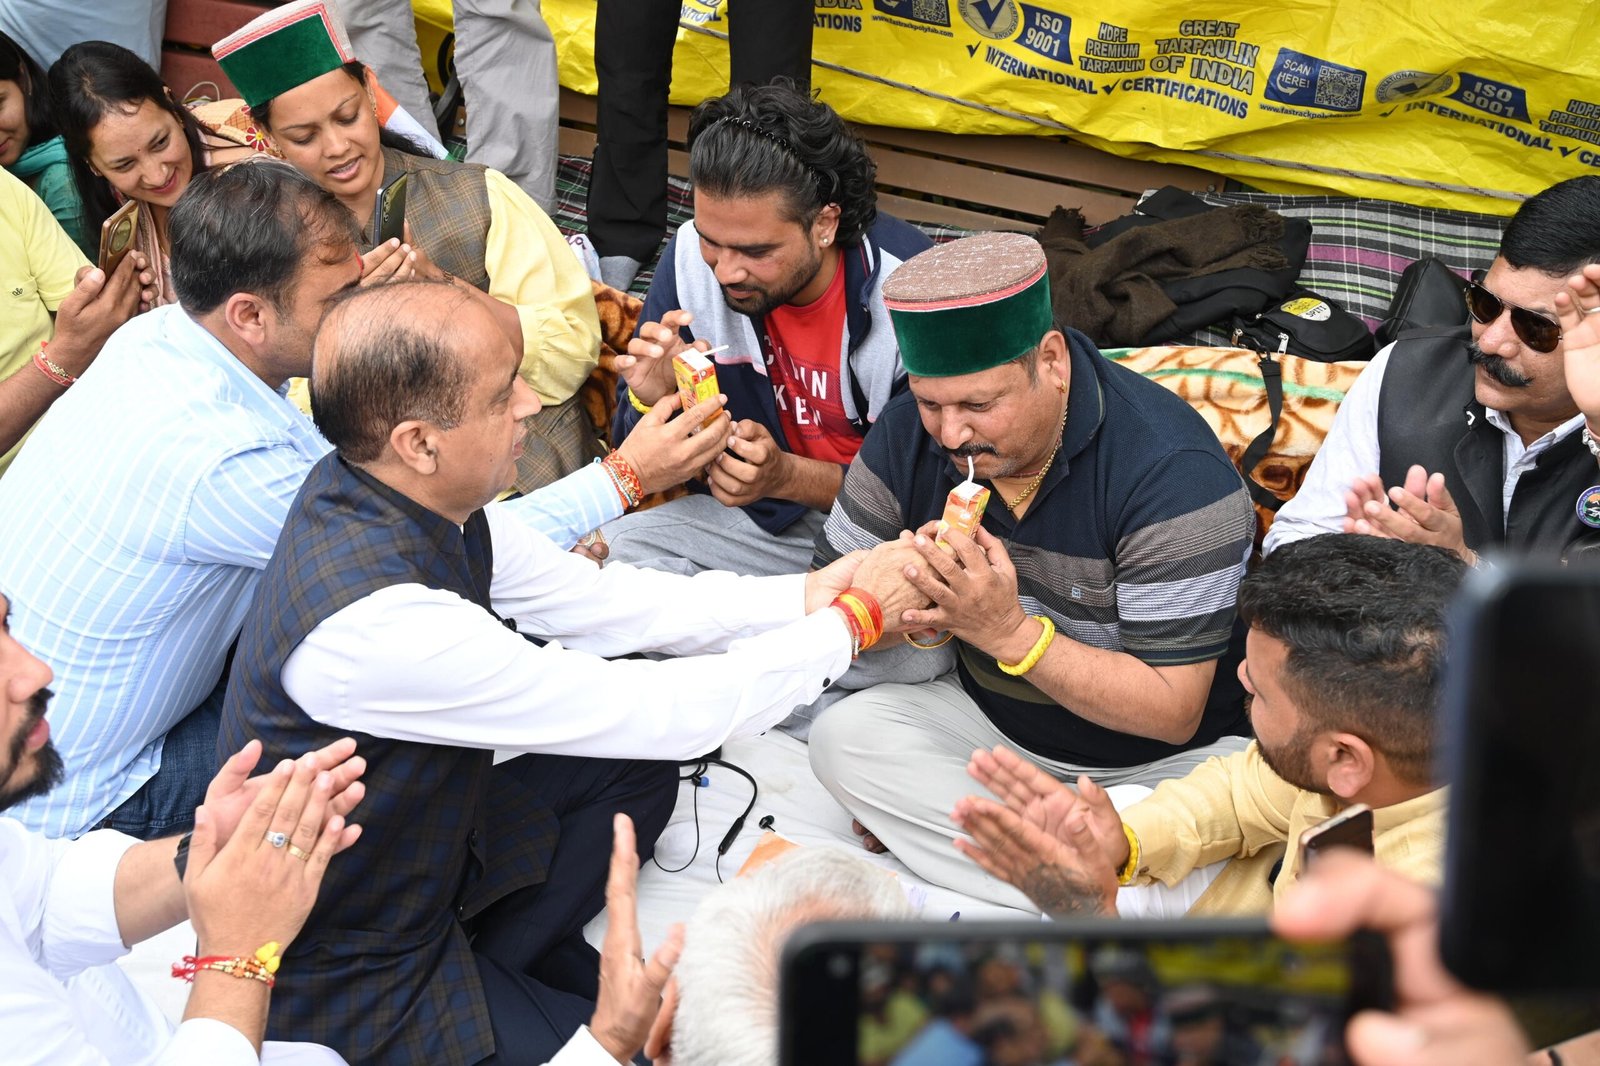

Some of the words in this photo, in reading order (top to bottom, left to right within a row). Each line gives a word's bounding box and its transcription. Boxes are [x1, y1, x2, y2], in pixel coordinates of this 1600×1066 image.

[1034, 12, 1063, 34] ISO
[1098, 22, 1128, 43] HDPE
[1179, 20, 1240, 38] GREAT
[1025, 27, 1061, 57] 9001
[1086, 39, 1140, 58] PREMIUM
[1155, 39, 1260, 68] TARPAULIN
[985, 45, 1098, 95] INTERNATIONAL
[1079, 56, 1145, 74] TARPAULIN
[1150, 56, 1186, 74] OF
[1190, 58, 1255, 95] INDIA
[1282, 58, 1312, 76] SCAN
[1278, 71, 1310, 88] HERE!
[1121, 77, 1248, 119] CERTIFICATIONS
[1473, 81, 1512, 102] ISO
[1462, 90, 1516, 117] 9001
[1404, 101, 1553, 151] INTERNATIONAL
[1548, 110, 1600, 133] PREMIU
[1306, 305, 1327, 318] SPITI
